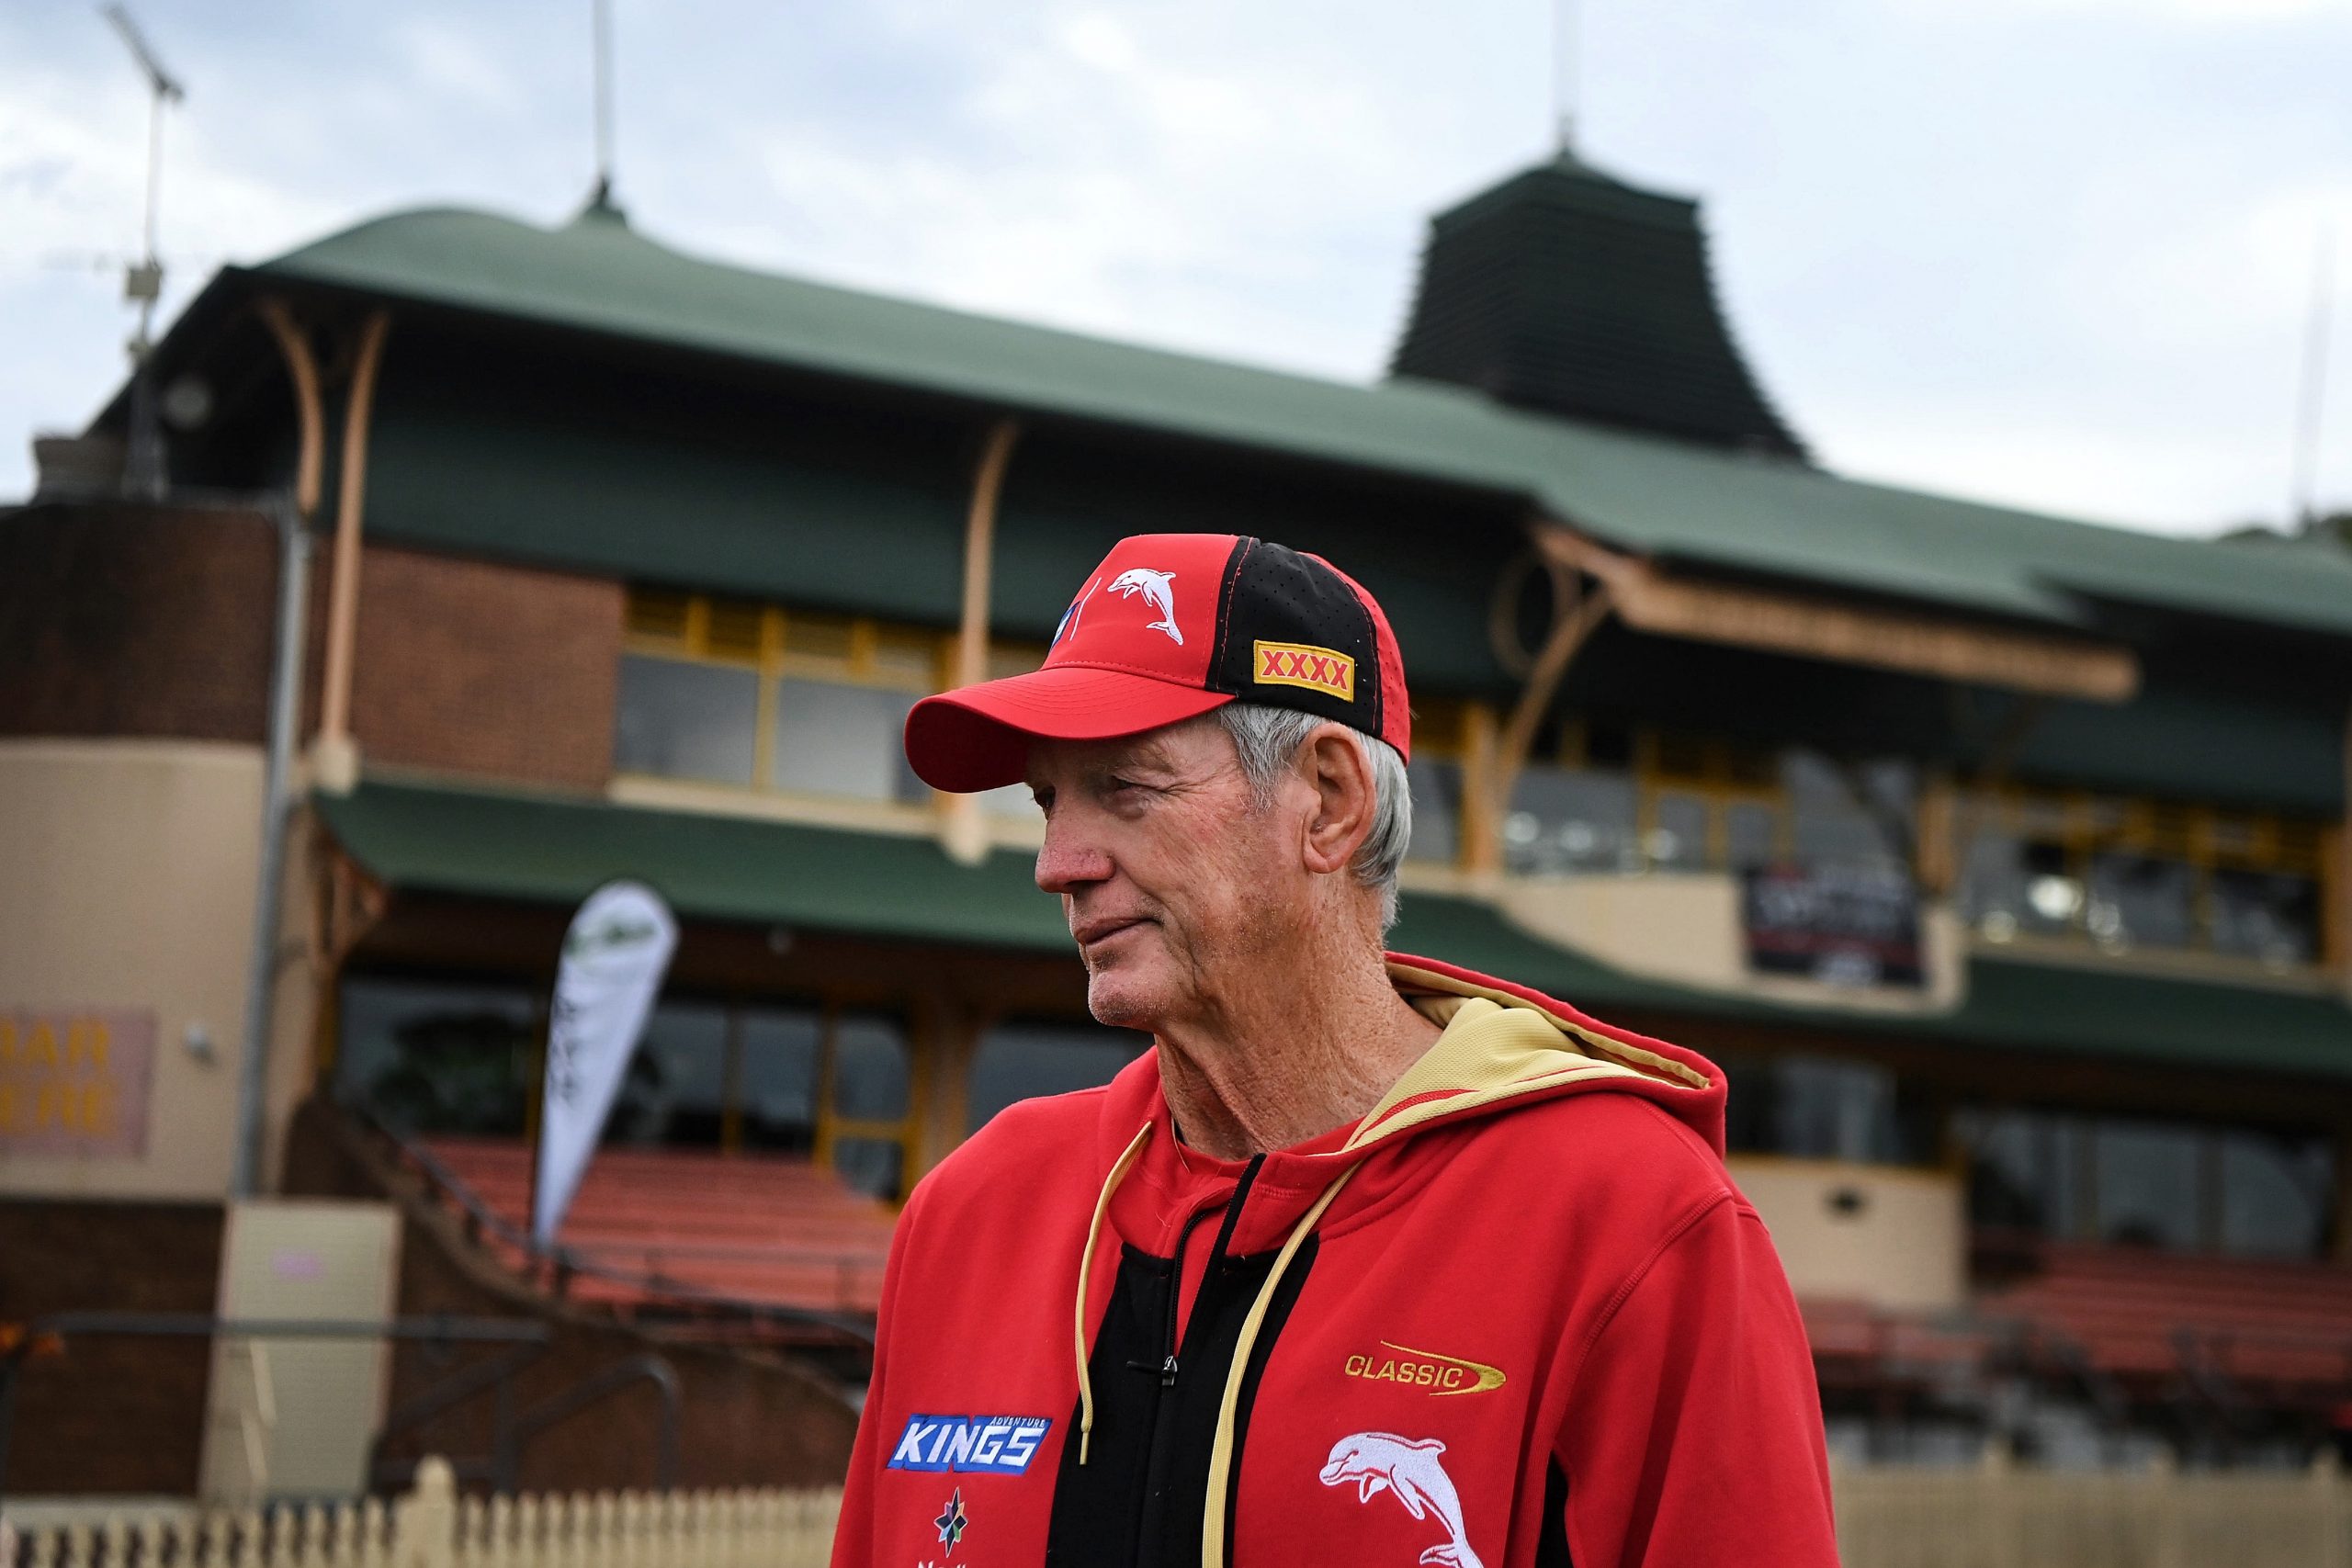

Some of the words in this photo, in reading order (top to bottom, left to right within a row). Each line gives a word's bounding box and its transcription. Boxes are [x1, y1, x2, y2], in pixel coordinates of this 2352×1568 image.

[1261, 649, 1349, 692] XXXX
[1344, 1355, 1464, 1389] CLASSIC
[989, 1416, 1046, 1428] ADVENTURE
[893, 1423, 1046, 1467] KINGS
